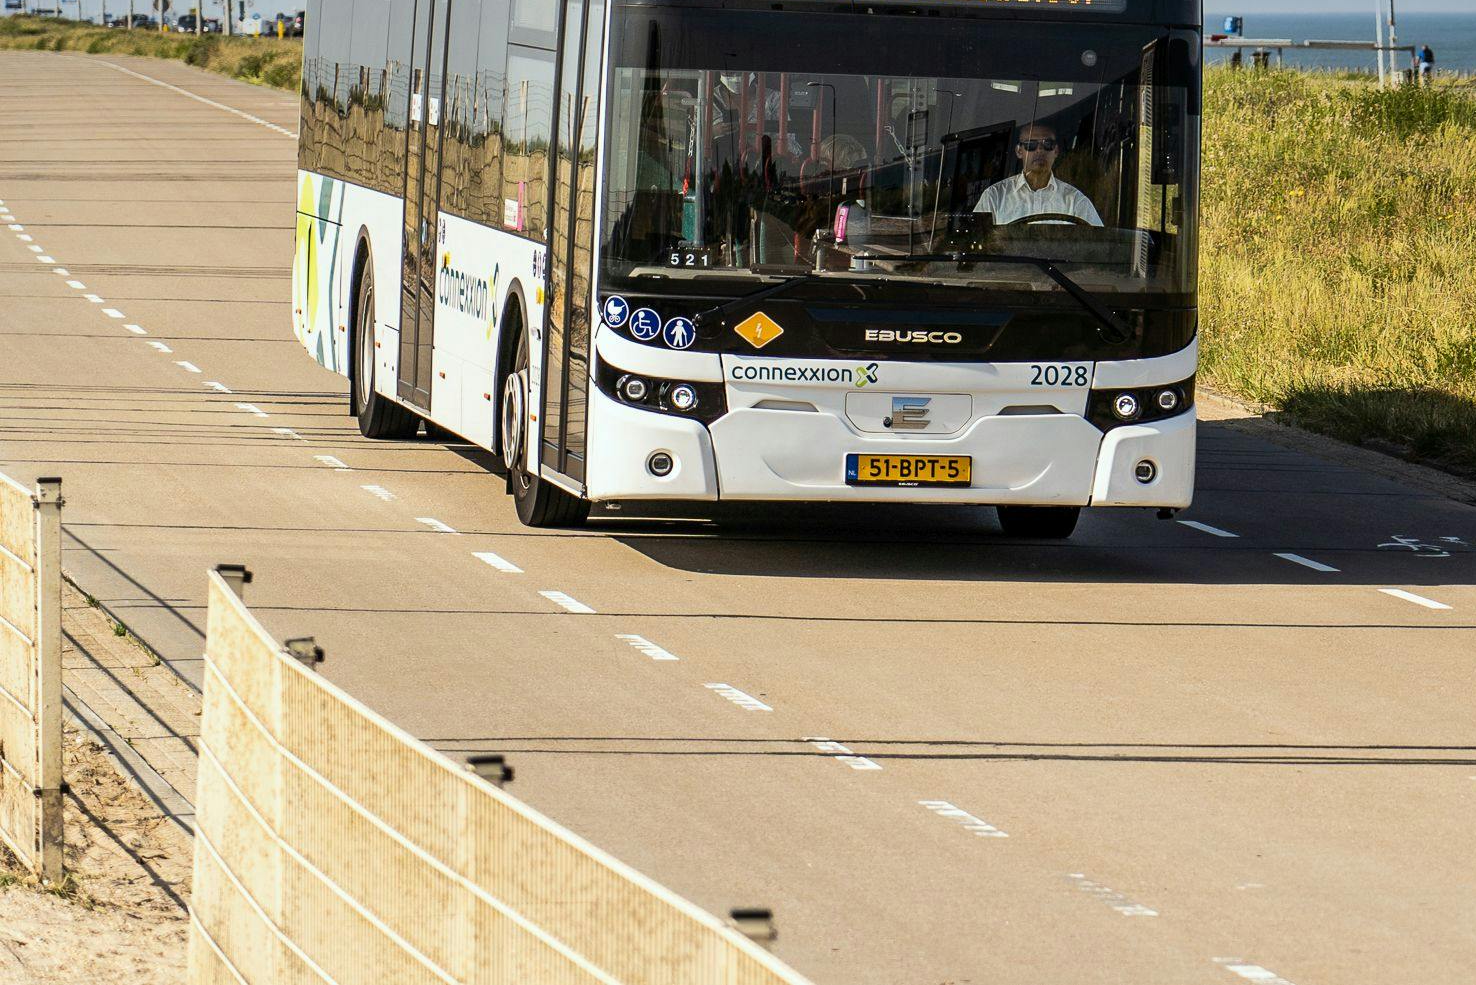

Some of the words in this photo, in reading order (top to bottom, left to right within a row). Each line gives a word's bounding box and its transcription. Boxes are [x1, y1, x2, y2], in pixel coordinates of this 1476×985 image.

[864, 329, 963, 344] EBUSCO
[731, 365, 853, 383] connexxion
[1030, 364, 1088, 387] 2028
[848, 469, 857, 477] NL
[869, 458, 960, 479] 51-BPT-5
